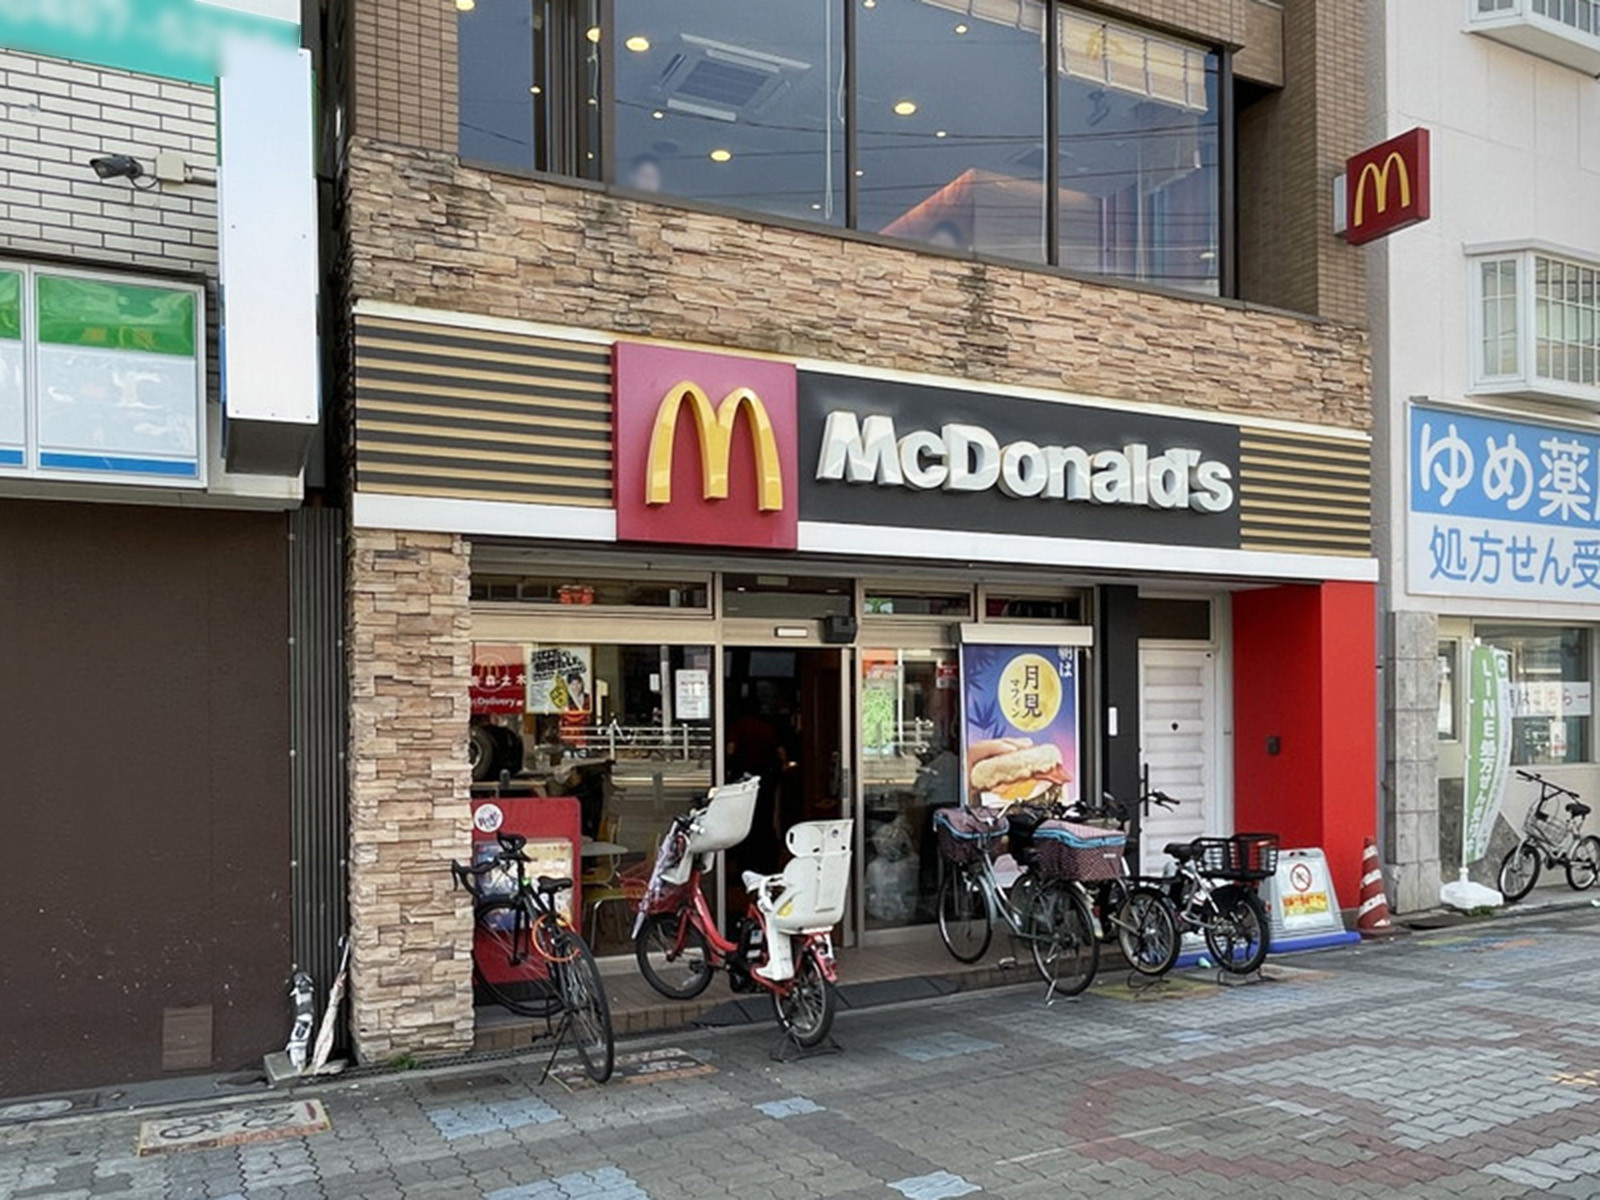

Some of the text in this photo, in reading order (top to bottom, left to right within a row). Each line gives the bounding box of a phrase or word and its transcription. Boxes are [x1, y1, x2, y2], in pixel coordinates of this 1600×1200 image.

[815, 410, 1235, 513] McDonald's
[1420, 423, 1600, 521] ゆめ薬
[1429, 525, 1600, 589] 処方せん受
[1022, 665, 1043, 719] 月見
